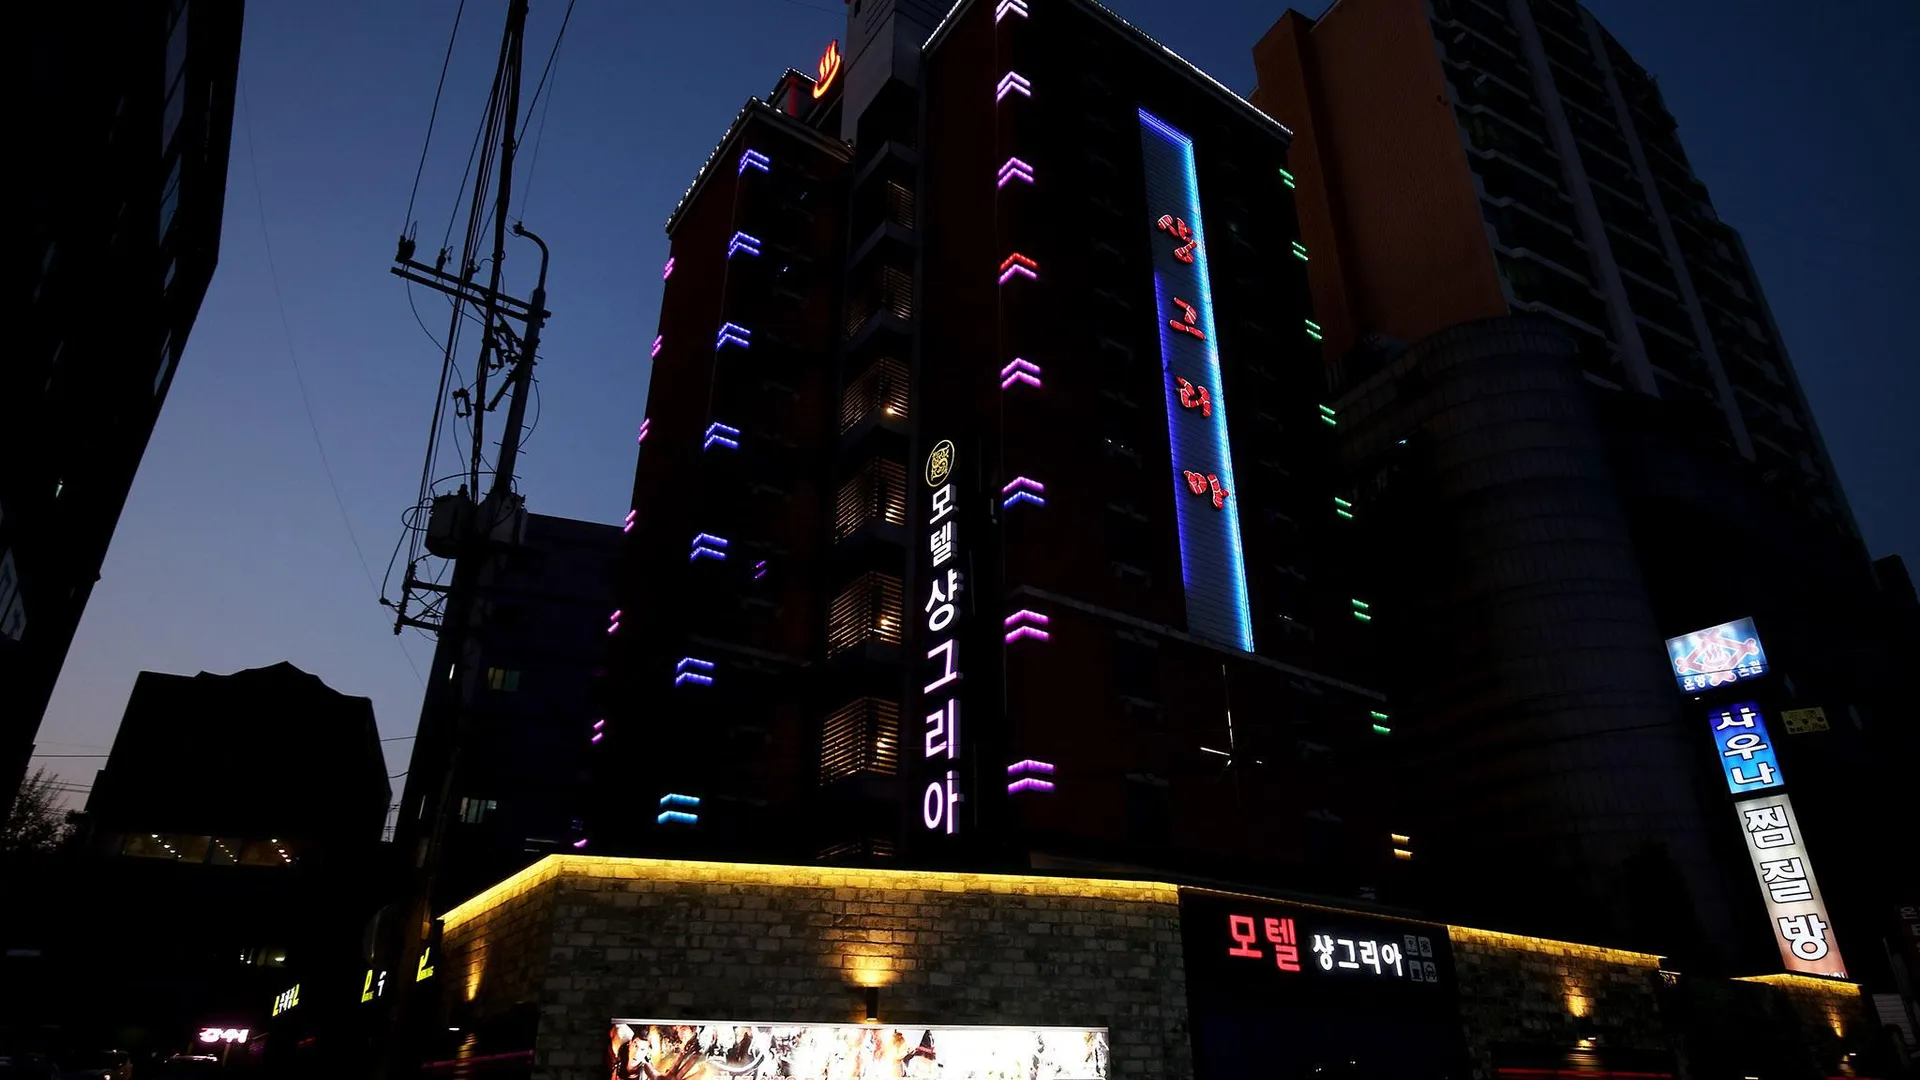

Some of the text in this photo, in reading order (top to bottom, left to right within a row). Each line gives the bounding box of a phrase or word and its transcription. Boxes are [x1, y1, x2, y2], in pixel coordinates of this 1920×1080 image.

[1716, 707, 1775, 785] 사우나
[1744, 804, 1829, 961] 찜질방
[1229, 914, 1403, 977] 모텔 샹그리아
